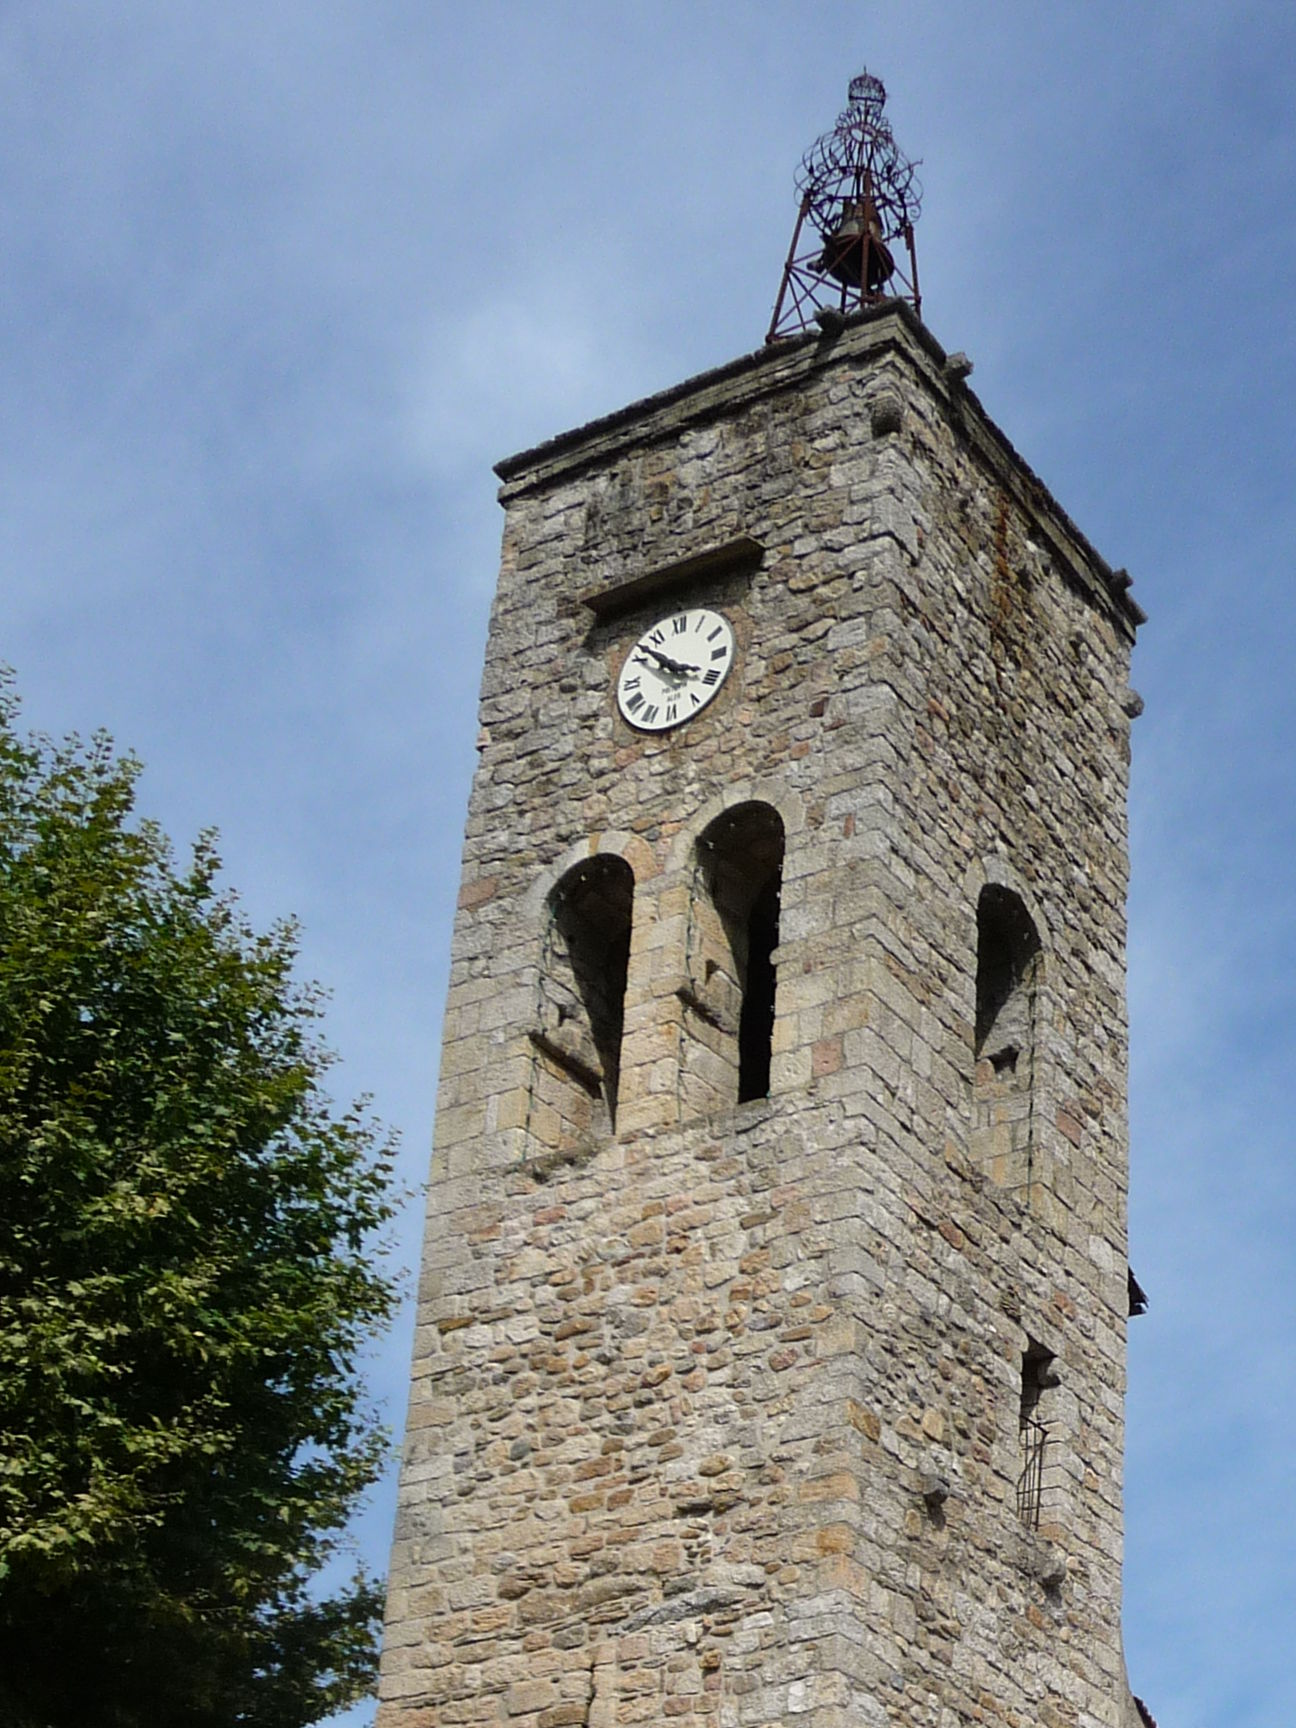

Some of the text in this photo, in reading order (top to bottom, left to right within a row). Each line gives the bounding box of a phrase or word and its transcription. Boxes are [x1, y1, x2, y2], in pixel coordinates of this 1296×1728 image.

[672, 615, 687, 636] XII
[695, 615, 705, 633] I
[649, 629, 665, 647] XI
[707, 625, 723, 642] II
[631, 654, 648, 662] X
[711, 646, 727, 661] III
[624, 676, 641, 691] IX
[702, 669, 721, 685] IIII
[625, 691, 646, 715] VIII
[690, 693, 700, 707] V
[641, 704, 659, 723] VII
[666, 704, 677, 722] VI
